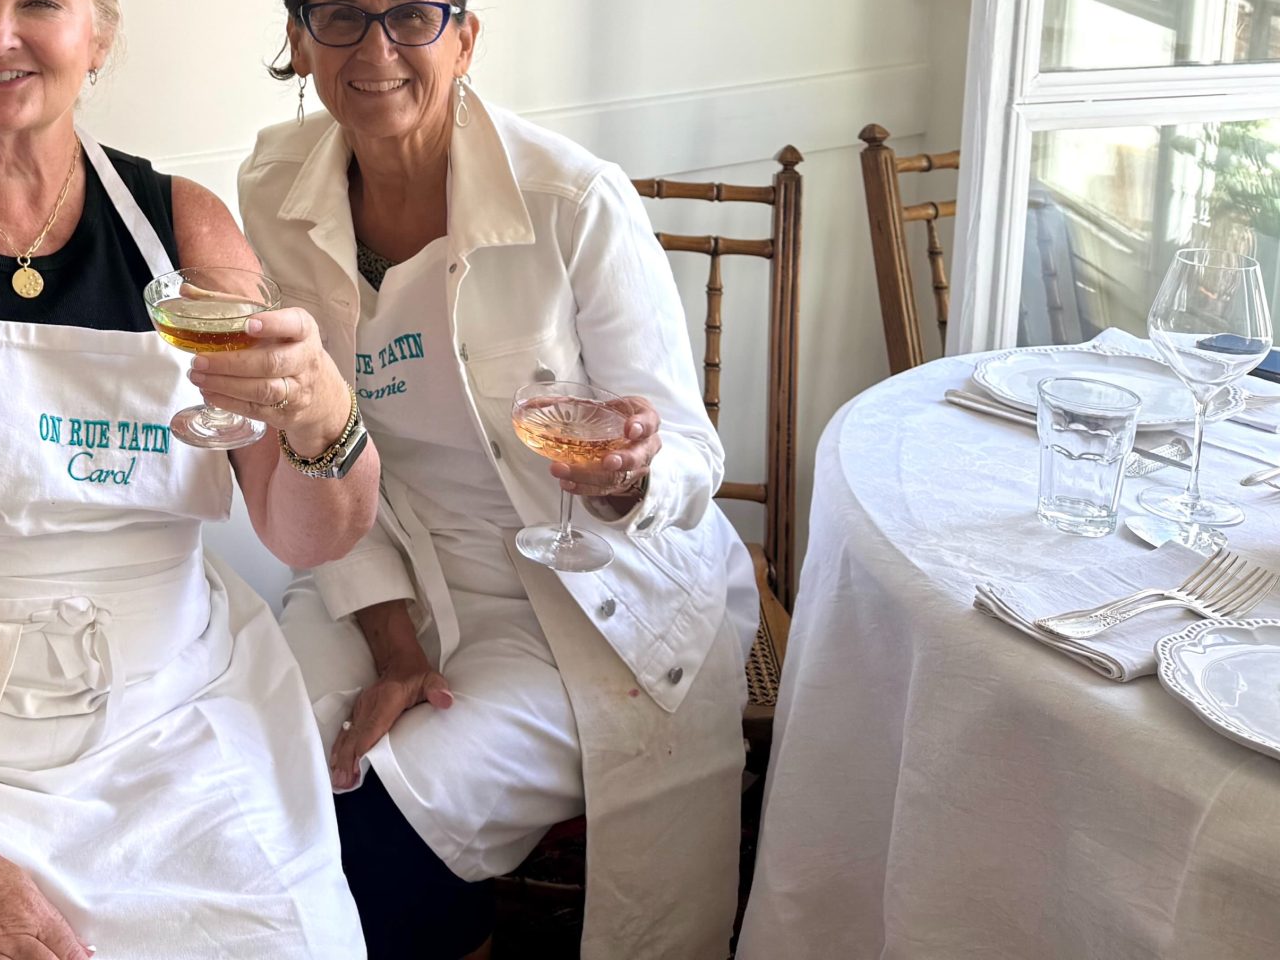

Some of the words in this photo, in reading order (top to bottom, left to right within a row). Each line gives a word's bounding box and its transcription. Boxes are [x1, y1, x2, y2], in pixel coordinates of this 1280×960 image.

[378, 332, 425, 369] TATIN
[355, 376, 408, 400] onnie
[39, 412, 63, 444] ON
[68, 418, 111, 449] RUE
[117, 420, 170, 454] TATIN
[67, 451, 137, 486] Carol
